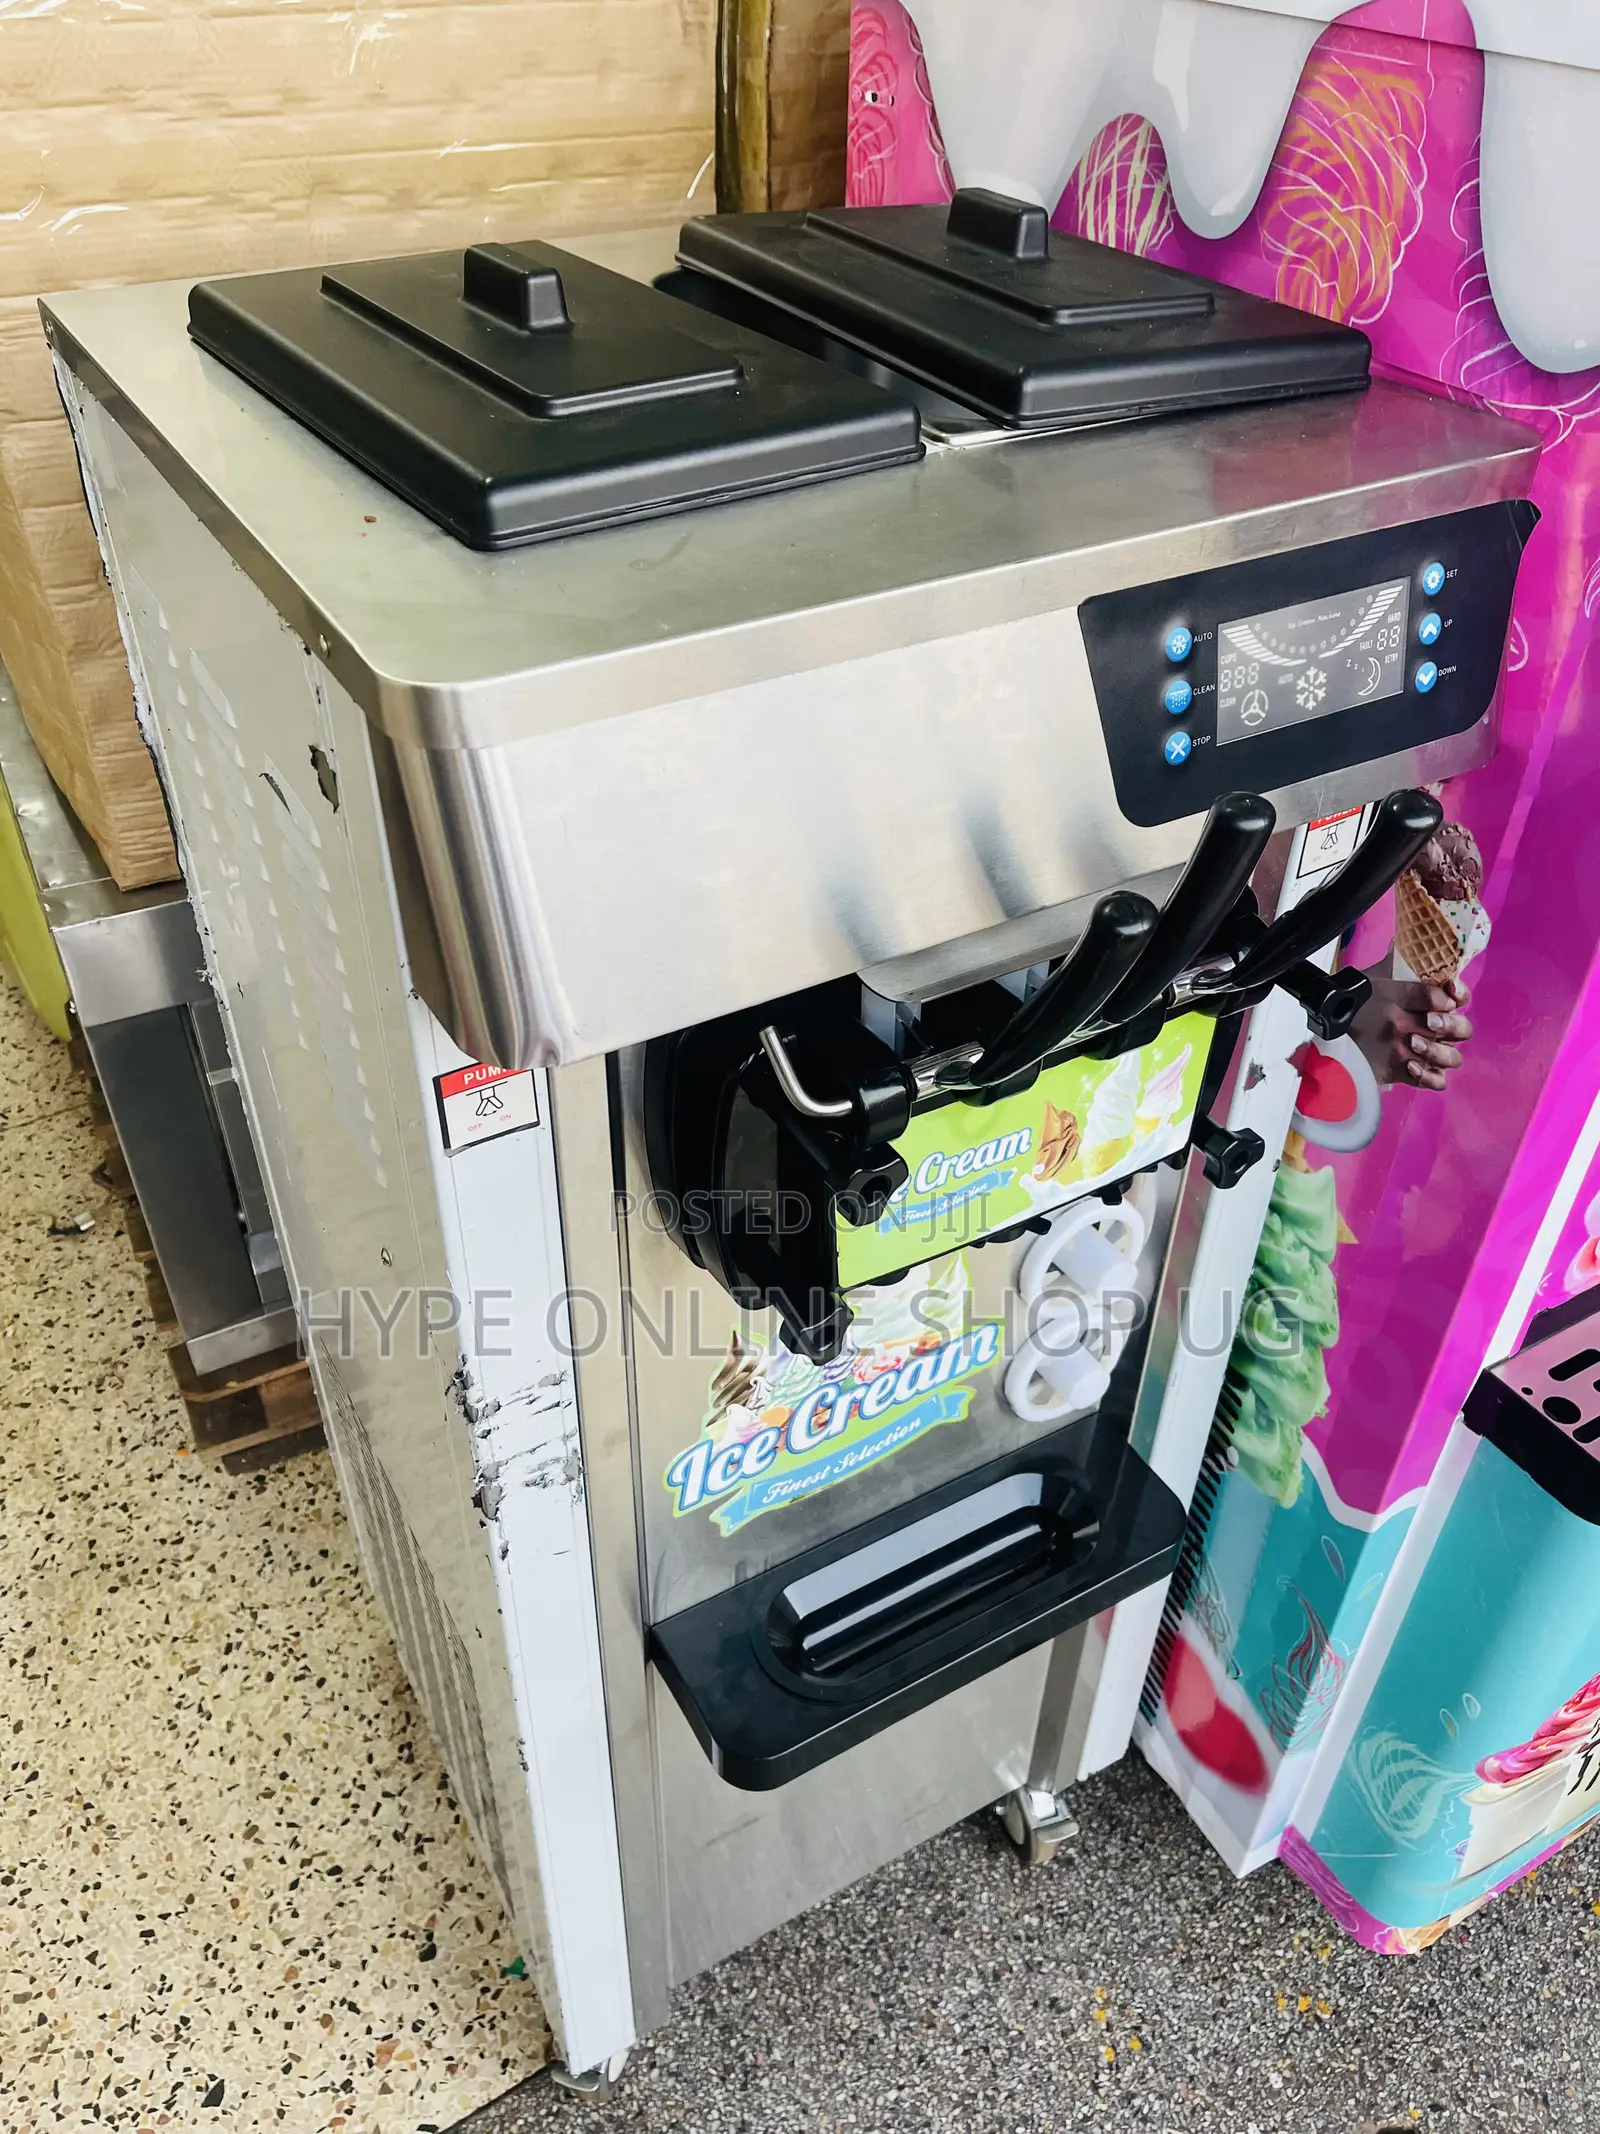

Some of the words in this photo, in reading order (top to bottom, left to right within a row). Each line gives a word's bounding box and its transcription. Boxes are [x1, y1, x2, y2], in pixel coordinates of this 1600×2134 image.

[1446, 568, 1458, 579] SET
[1444, 619, 1453, 627] UP
[1193, 631, 1213, 643] AUTO
[1438, 665, 1457, 677] DOWN
[1193, 684, 1216, 696] CLEAN
[1192, 735, 1211, 747] STOP
[463, 1065, 508, 1085] PUM
[468, 1122, 483, 1132] OFF
[914, 1127, 1032, 1194] Cream
[667, 1426, 782, 1511] Ice
[787, 1322, 1000, 1454] Cream
[762, 1464, 831, 1504] Finest
[833, 1416, 922, 1475] Selection
